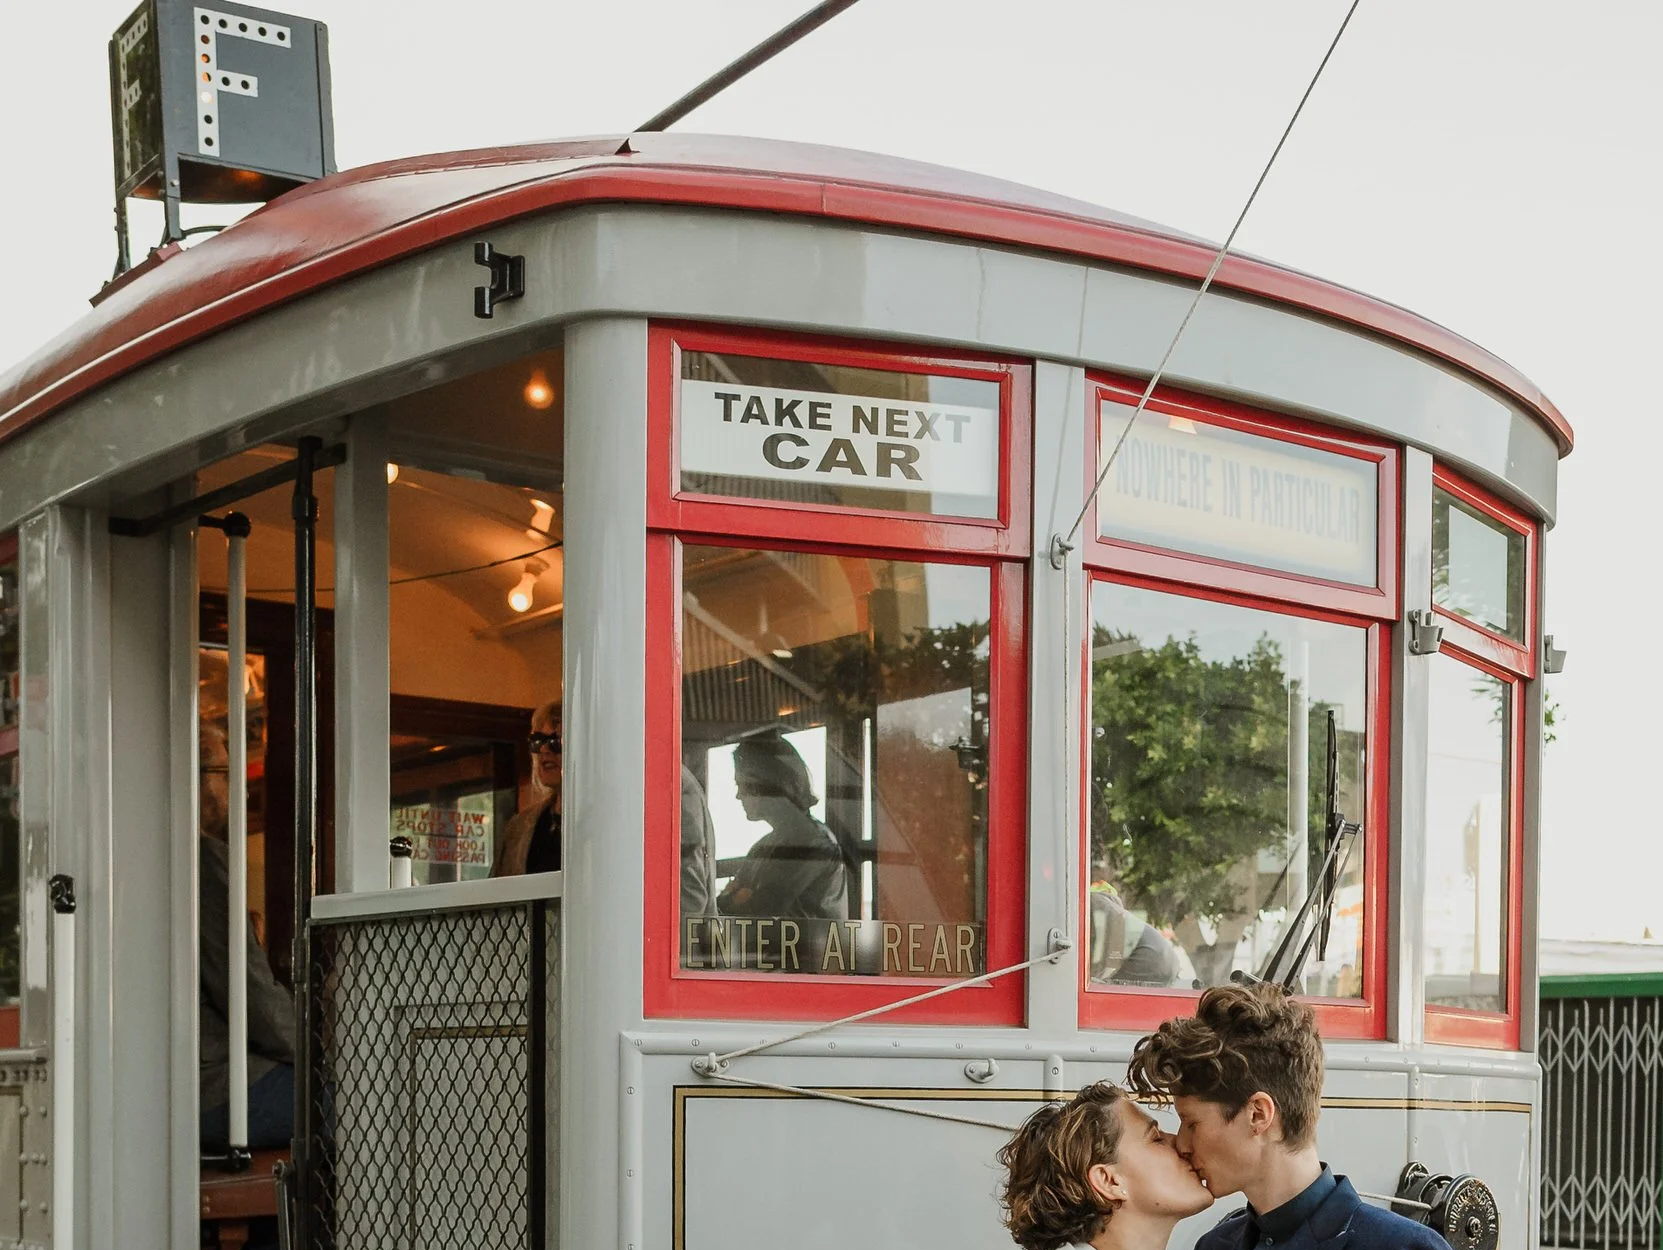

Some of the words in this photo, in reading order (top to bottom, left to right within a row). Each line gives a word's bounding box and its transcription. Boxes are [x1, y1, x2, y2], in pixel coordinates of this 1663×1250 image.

[119, 11, 149, 183] F
[193, 6, 292, 158] F
[714, 391, 832, 431] TAKE
[852, 405, 971, 443] NEXT
[762, 432, 923, 481] CAR
[1116, 436, 1212, 513] NOWHERE
[1222, 458, 1241, 520] IN
[1250, 466, 1360, 545] PARTICULAR
[685, 917, 800, 970] ENTER
[822, 920, 861, 971] AT
[882, 922, 976, 974] REAR
